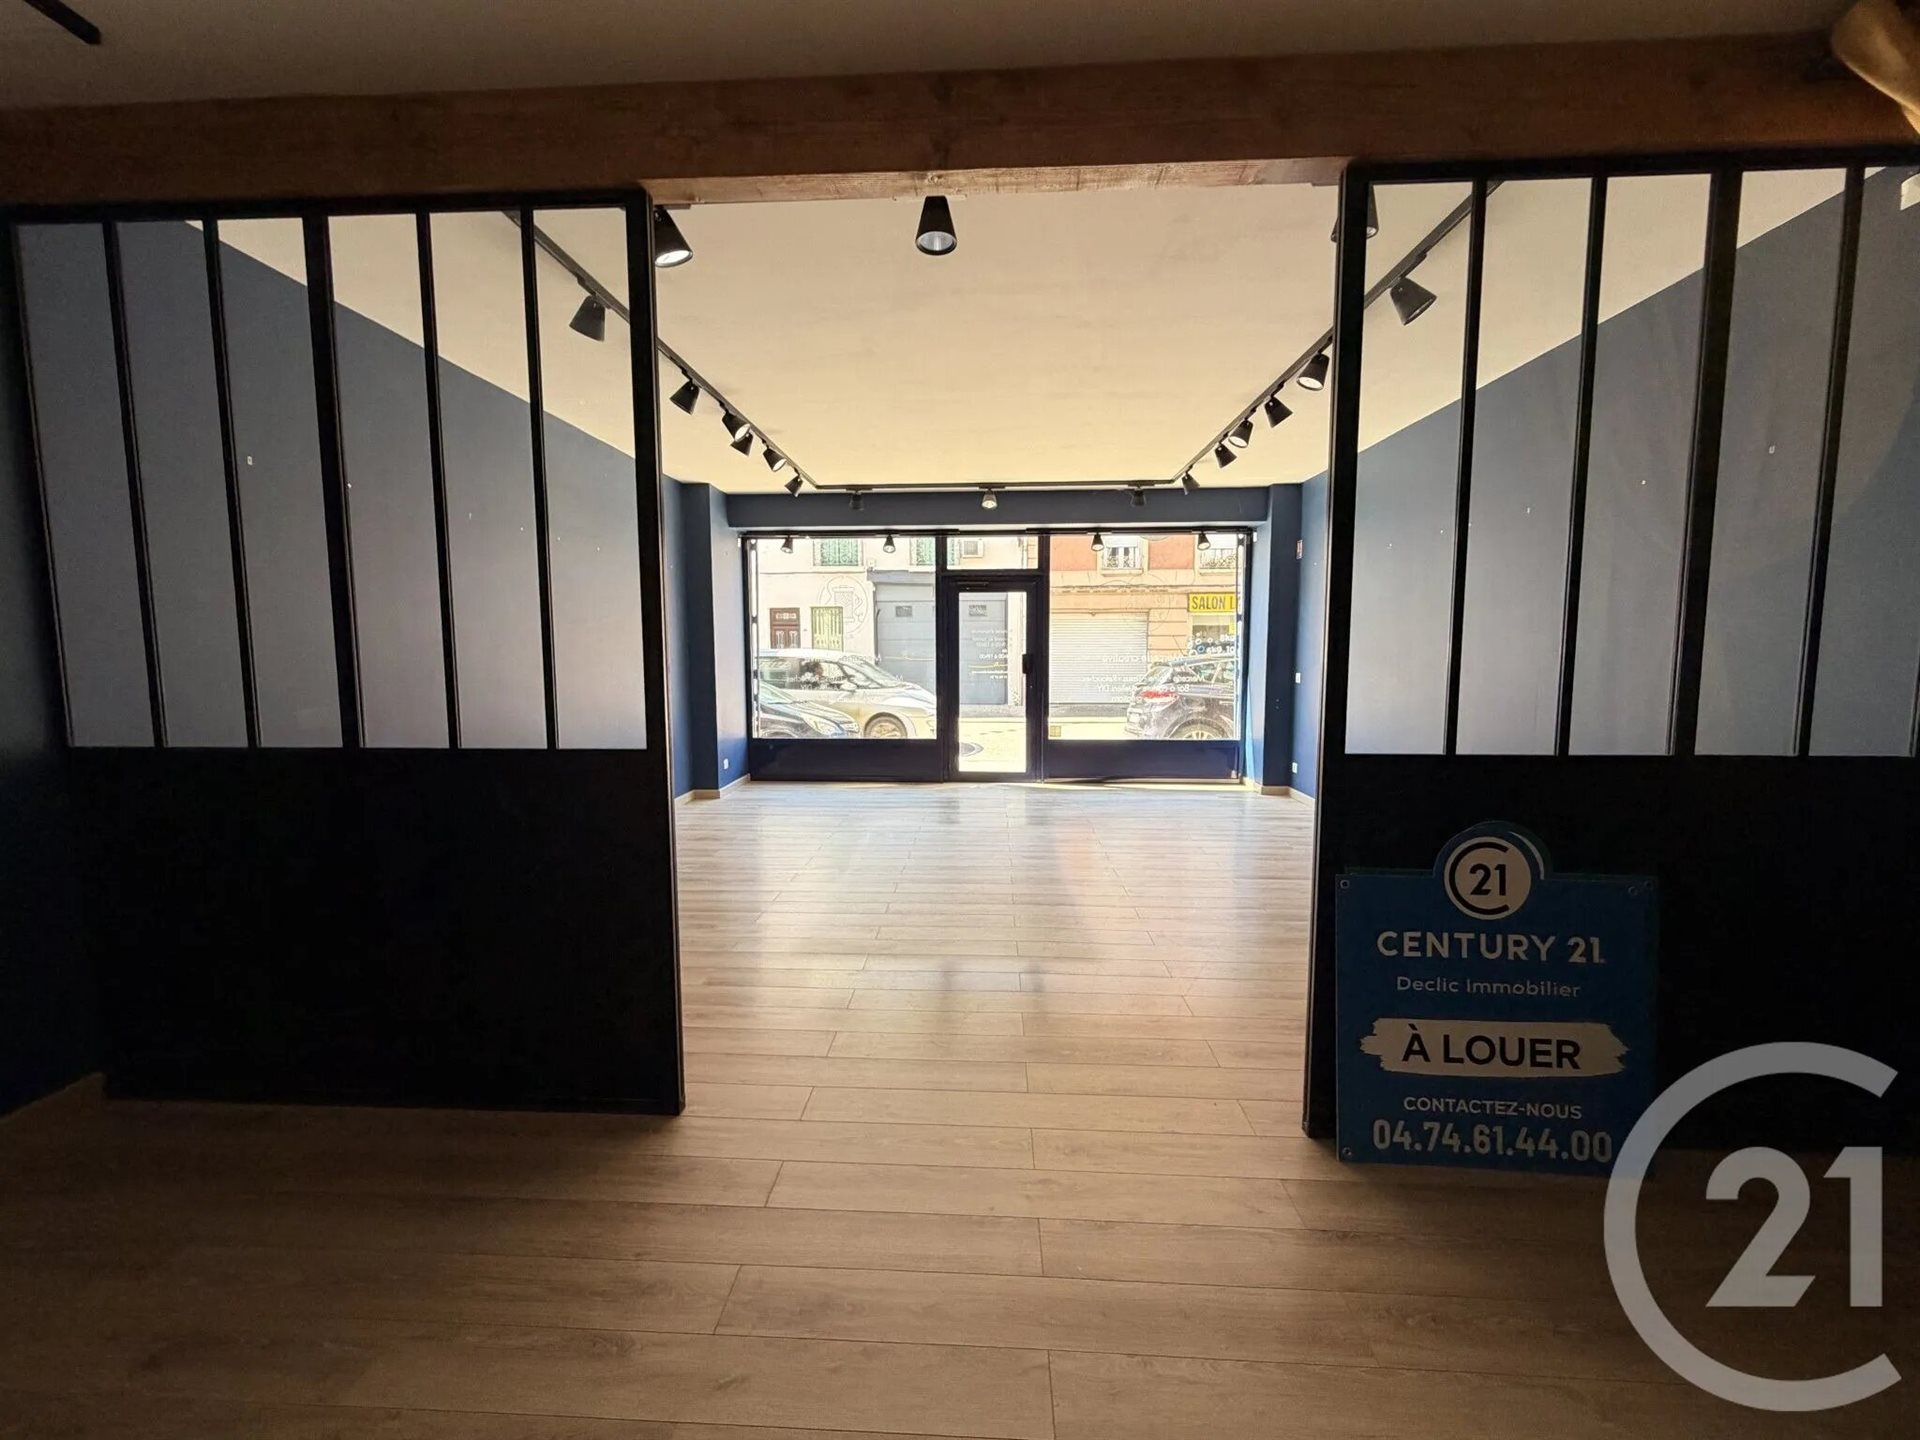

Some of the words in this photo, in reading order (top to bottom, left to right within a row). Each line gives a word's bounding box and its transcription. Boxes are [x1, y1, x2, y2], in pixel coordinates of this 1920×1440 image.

[1191, 595, 1226, 610] SALON
[1469, 863, 1506, 896] 21
[1376, 930, 1557, 963] CENTURY
[1396, 976, 1459, 994] Declic
[1466, 977, 1581, 998] Immobilier
[1401, 1023, 1430, 1063] À
[1442, 1034, 1582, 1070] LOUER
[1402, 1096, 1583, 1120] CONTACTEZ-NOUS
[1372, 1118, 1613, 1164] 04.74.61.44.00
